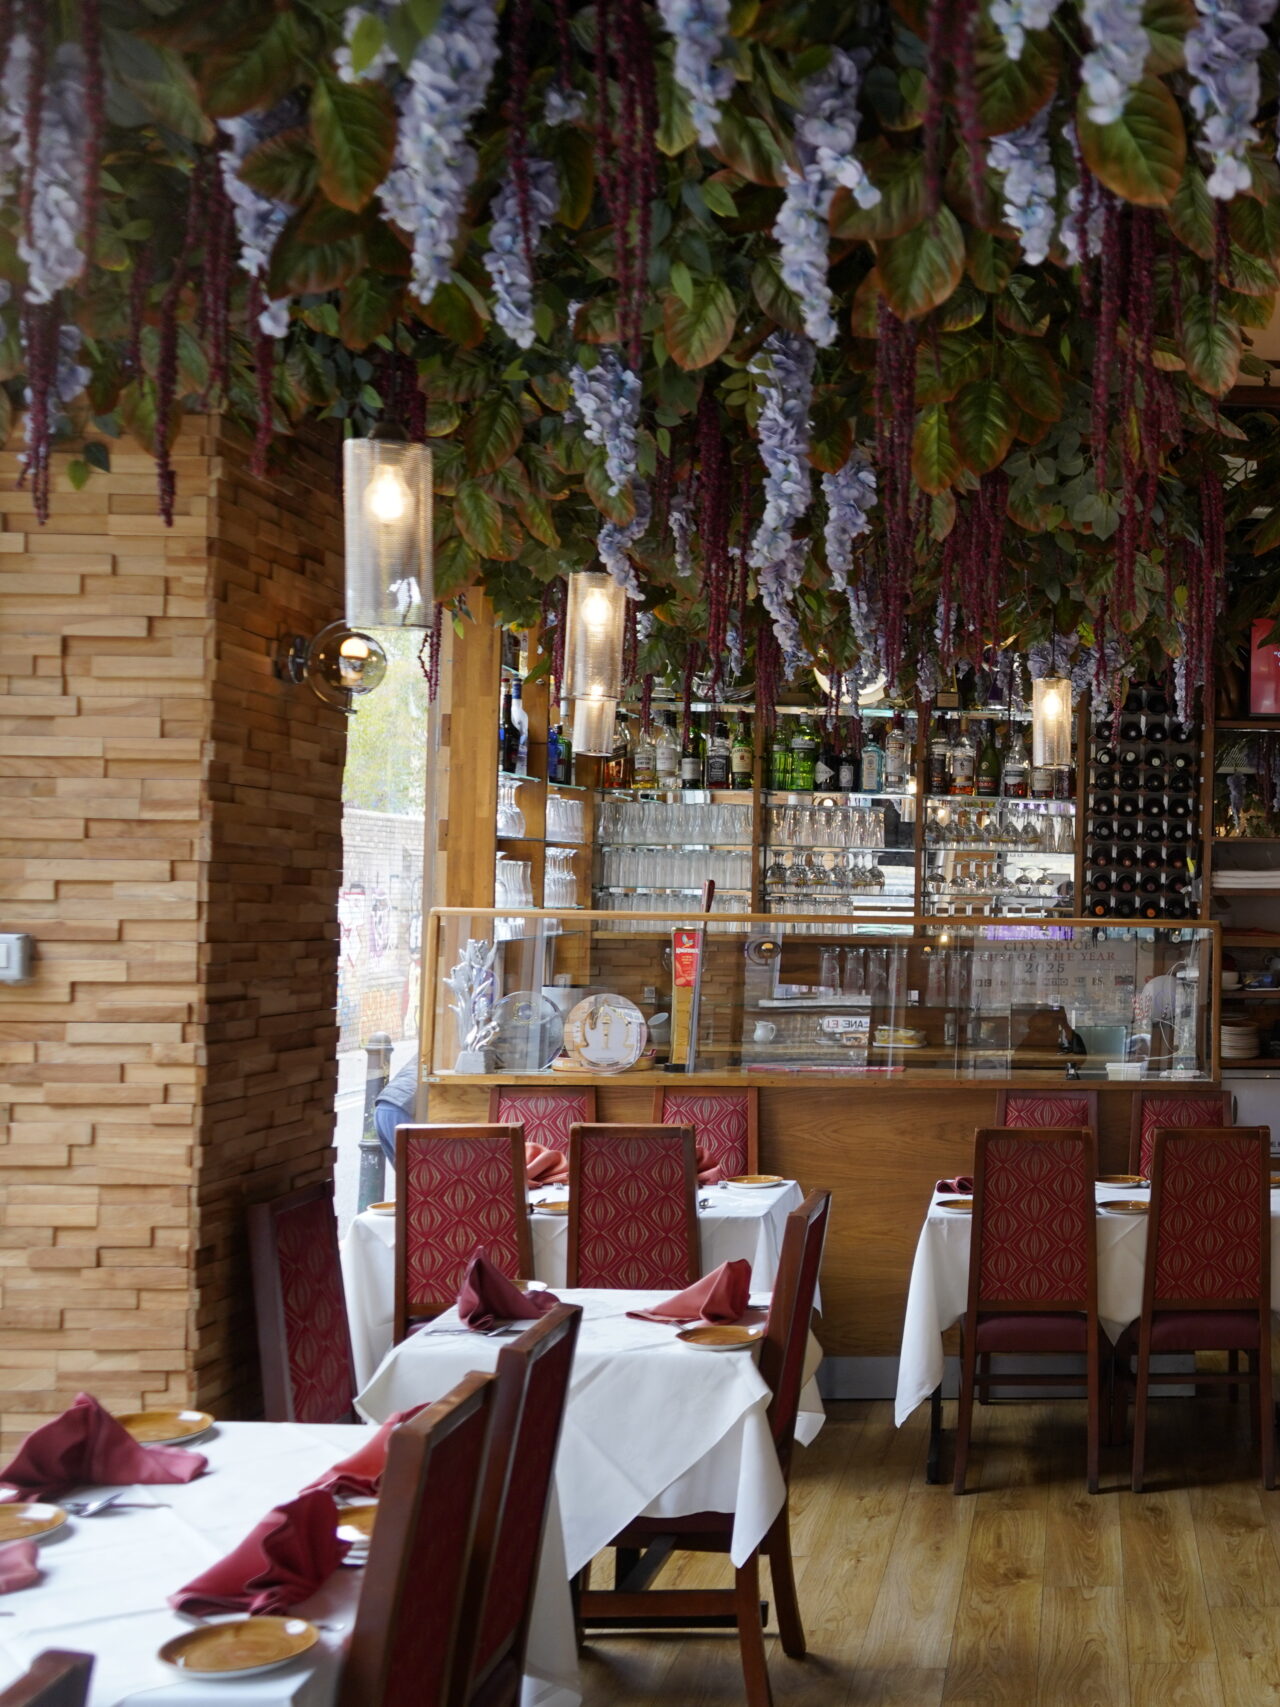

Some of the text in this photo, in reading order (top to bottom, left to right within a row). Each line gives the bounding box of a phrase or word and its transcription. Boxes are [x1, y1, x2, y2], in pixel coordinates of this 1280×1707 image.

[1003, 941, 1092, 951] CITY SPICE
[1045, 952, 1073, 961] THE
[1081, 952, 1115, 961] YEAR
[1025, 962, 1065, 973] 2025
